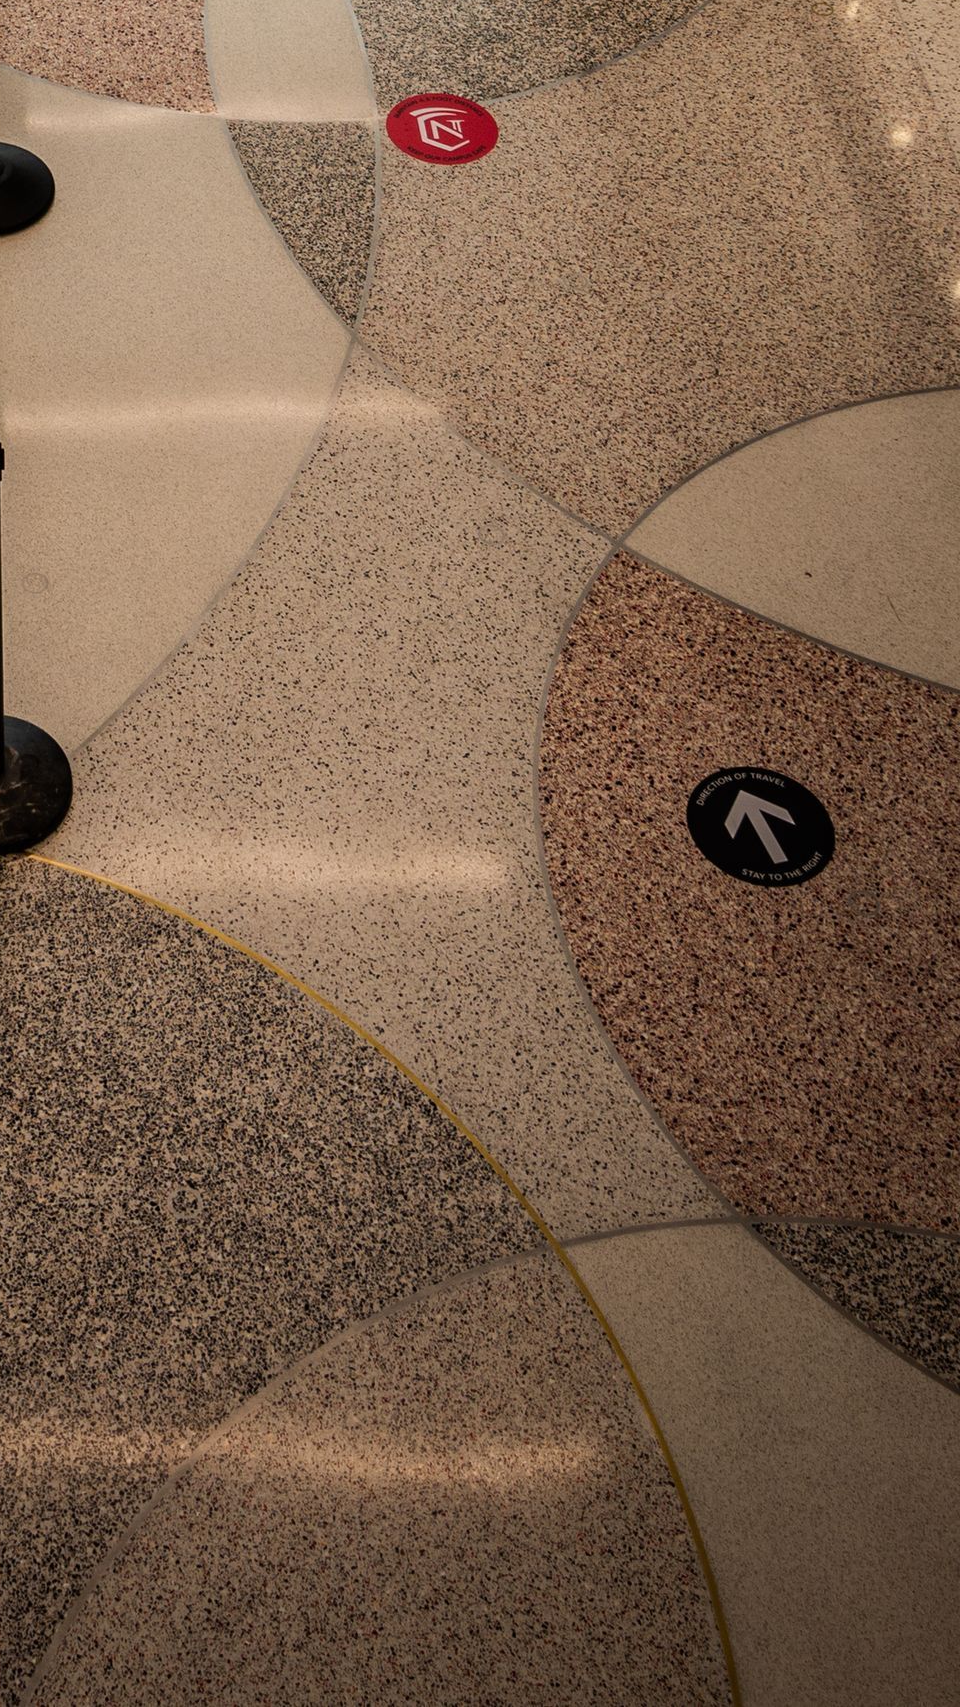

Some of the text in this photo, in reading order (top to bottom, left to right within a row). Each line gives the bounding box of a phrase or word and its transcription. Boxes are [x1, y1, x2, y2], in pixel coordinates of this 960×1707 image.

[696, 772, 785, 806] DIRECTION OF TRAVEL
[742, 852, 823, 881] STAY TO THE RIGHT
